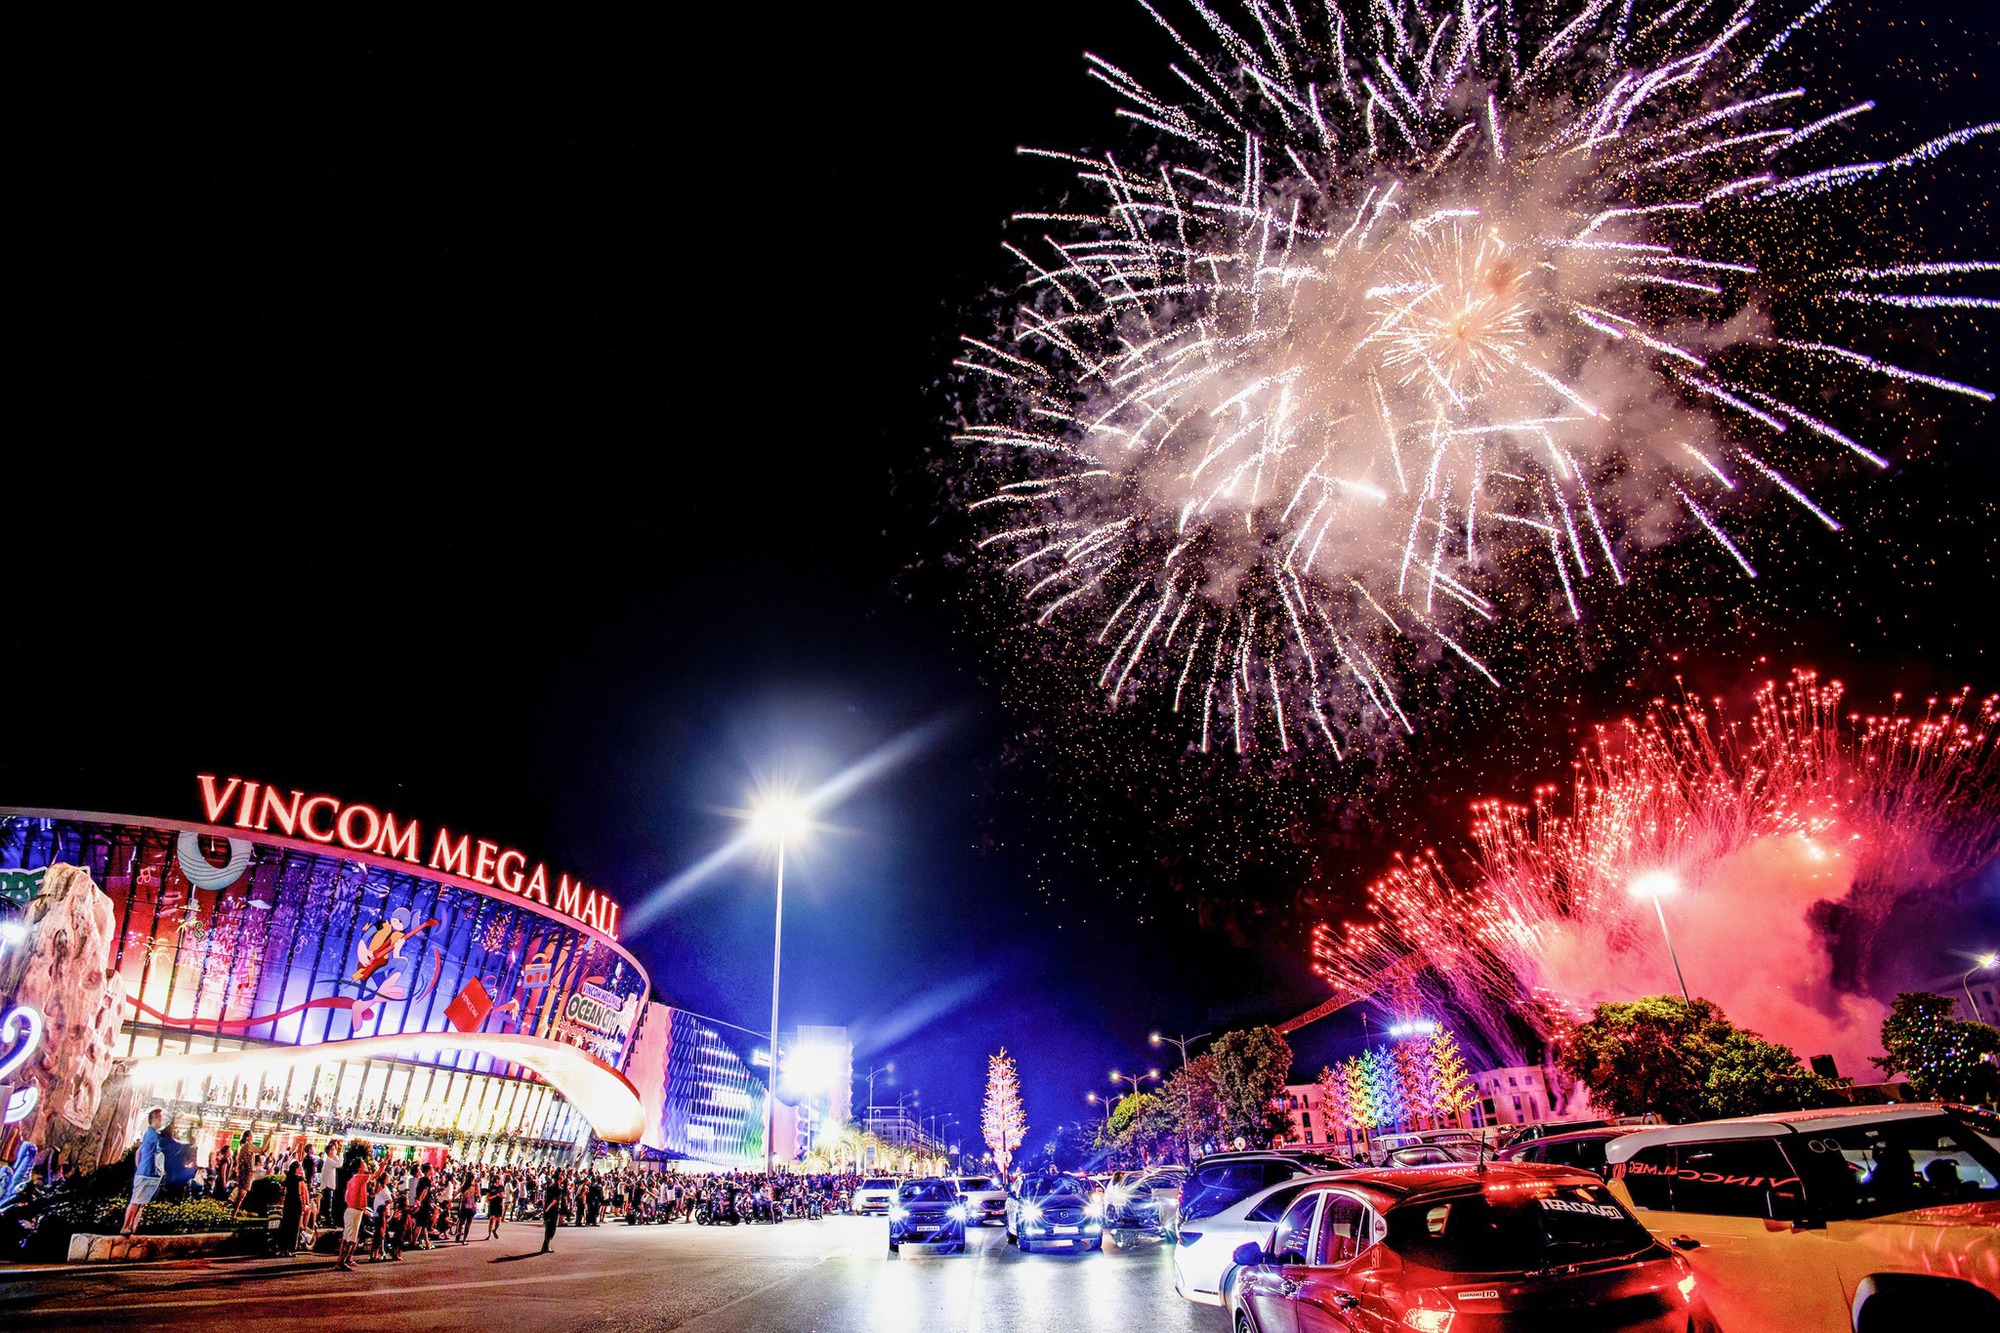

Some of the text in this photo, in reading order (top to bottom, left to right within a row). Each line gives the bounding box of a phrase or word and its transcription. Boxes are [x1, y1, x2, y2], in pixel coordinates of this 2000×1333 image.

[197, 775, 619, 941] VINCOM MEGA MALL
[461, 992, 479, 1018] VINCOM
[568, 996, 605, 1026] OCEAN
